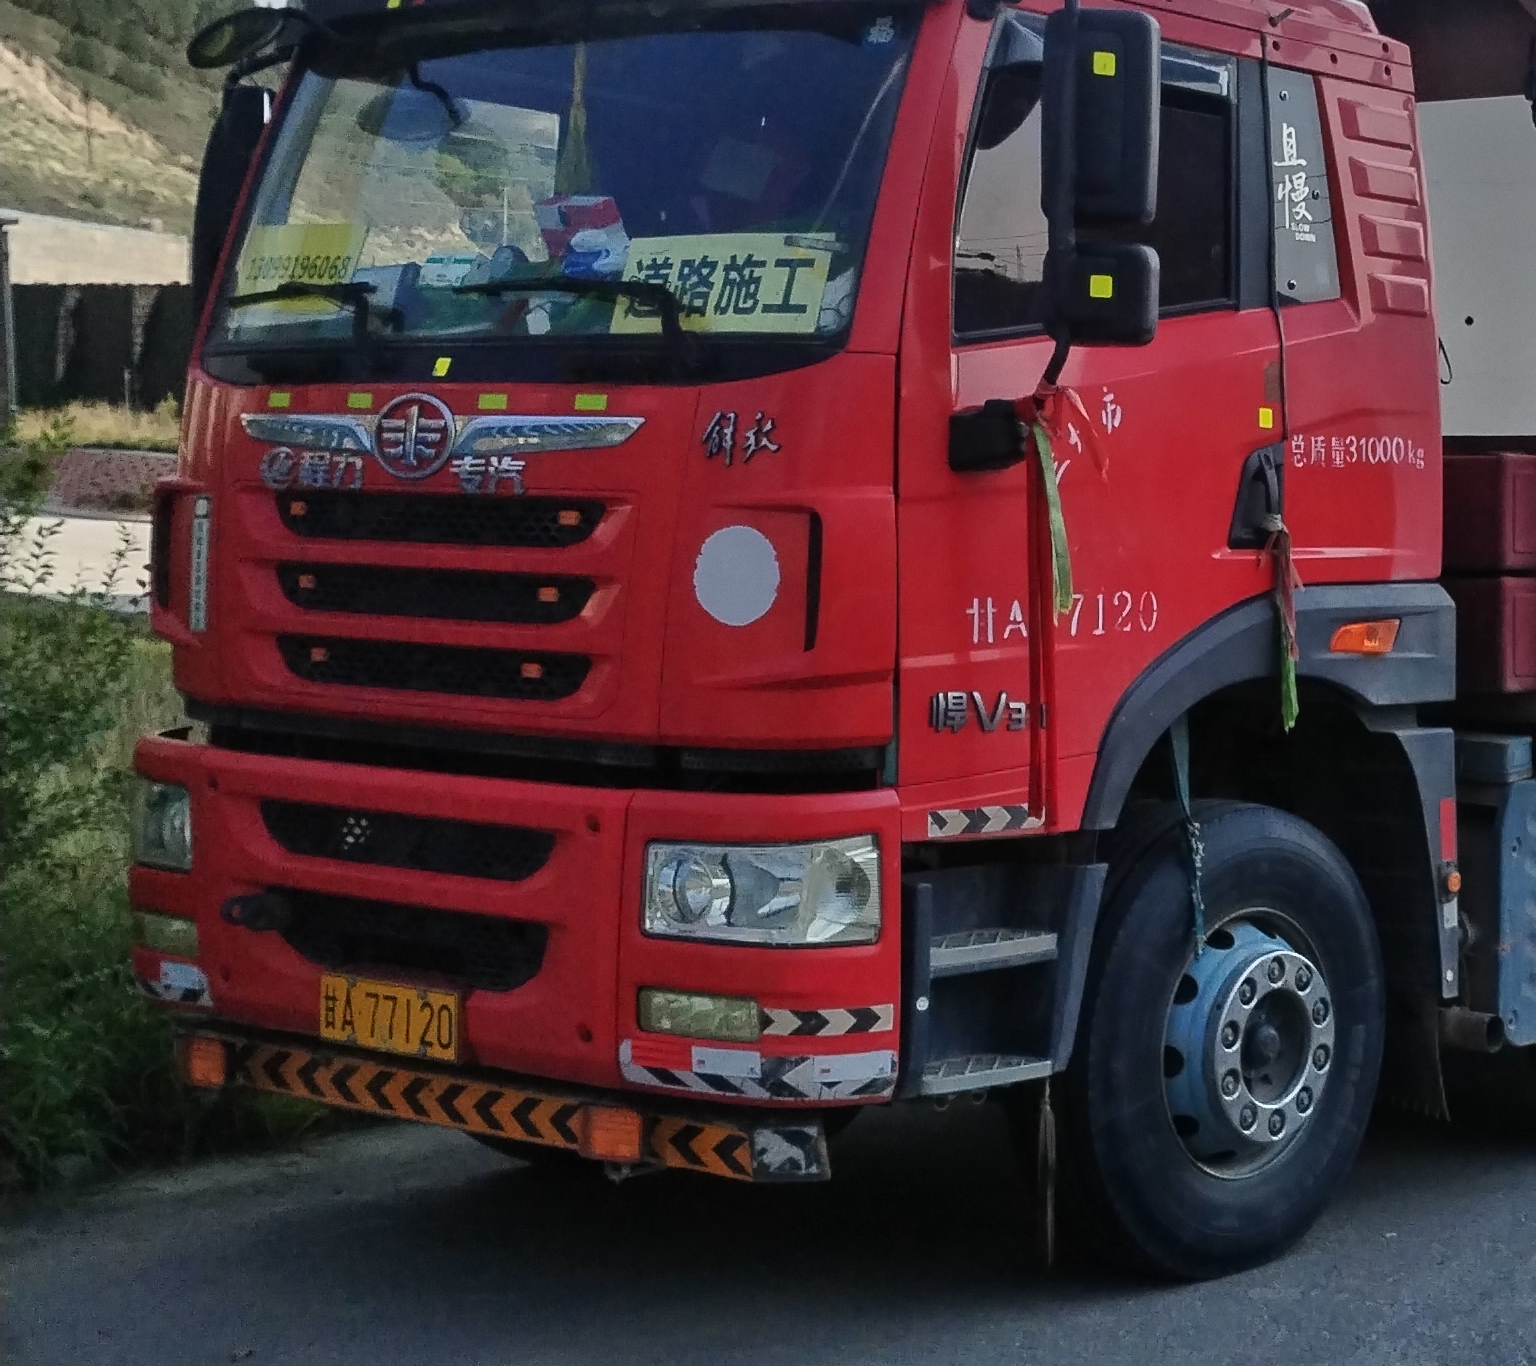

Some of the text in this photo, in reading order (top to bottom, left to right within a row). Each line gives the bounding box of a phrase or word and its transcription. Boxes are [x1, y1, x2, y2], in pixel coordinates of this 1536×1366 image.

[1273, 122, 1312, 229] 且慢
[623, 253, 817, 318] 道路施工
[450, 455, 527, 495] 专汽
[965, 590, 1159, 644] 甘A7120
[930, 691, 1047, 733] 悍V3
